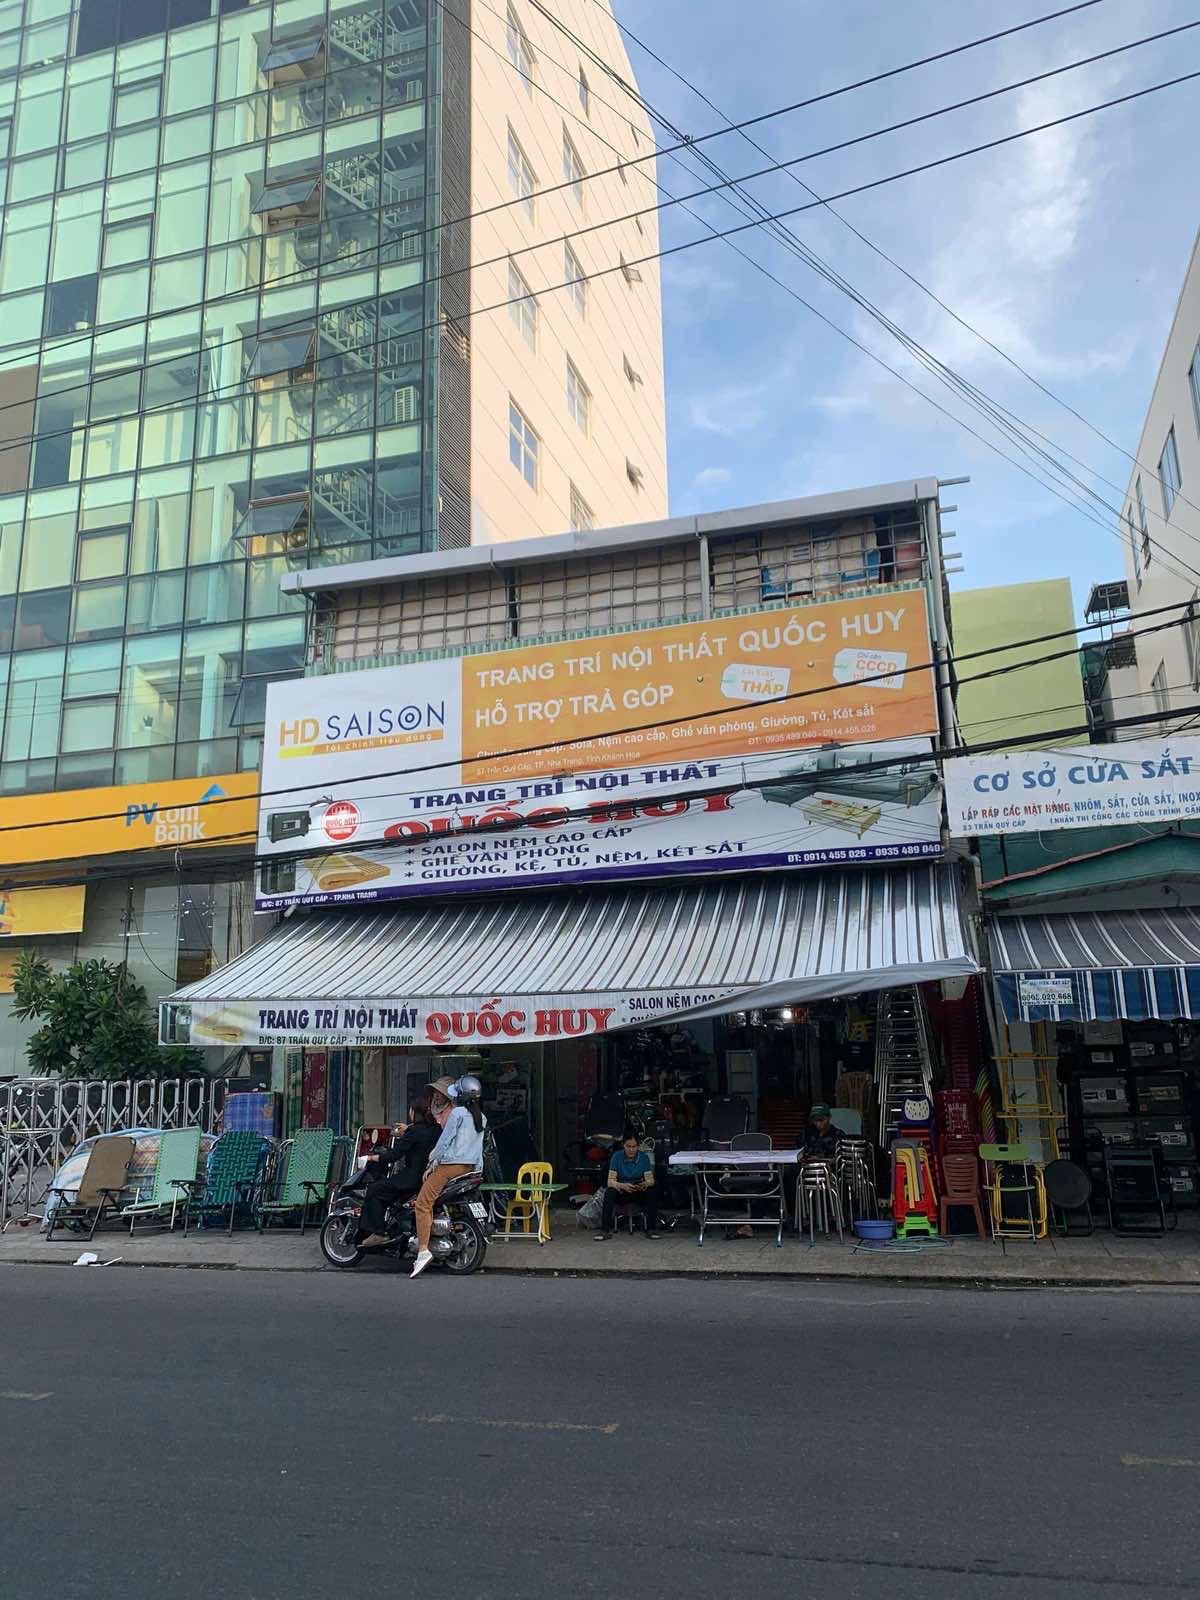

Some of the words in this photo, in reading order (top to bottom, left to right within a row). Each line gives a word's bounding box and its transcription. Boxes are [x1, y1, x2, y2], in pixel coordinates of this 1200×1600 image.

[476, 662, 554, 689] TRANG
[564, 651, 601, 676] TRÍ
[611, 646, 653, 671] NỘI
[663, 632, 728, 662] THẤT
[738, 614, 826, 652] QUỐC
[841, 608, 905, 638] HUY
[475, 697, 507, 728] HỖ
[514, 698, 563, 723] TRỢ
[568, 688, 616, 716] TRẢ
[622, 682, 674, 709] GÓP
[279, 718, 320, 746] HD
[326, 701, 445, 741] SAISON
[625, 733, 643, 744] cao
[671, 722, 694, 738] Ghế
[974, 770, 1010, 793] CƠ
[1022, 761, 1056, 789] SỞ
[1068, 757, 1129, 785] CỬA
[1141, 748, 1193, 778] SẮT
[409, 787, 506, 809] TRANG
[516, 779, 563, 799] TRÍ
[575, 773, 629, 791] NỘI
[640, 762, 721, 785] THẤT
[1002, 804, 1021, 817] CÁC
[1131, 792, 1150, 807] CỬA
[1091, 811, 1113, 821] CÔNG
[1134, 807, 1155, 817] CÔNG
[155, 821, 206, 843] Bank
[421, 841, 486, 856] SALON
[494, 837, 537, 850] NỆM
[544, 832, 585, 845] CAO
[592, 825, 633, 840] CẤP
[421, 864, 507, 880] GIƯỜNG,
[515, 859, 546, 872] KỆ,
[595, 849, 649, 864] NỆM,
[657, 845, 698, 858] KÉT
[516, 843, 590, 860] PHÒNG
[803, 852, 827, 862] 0914
[829, 850, 847, 860] 455
[848, 849, 867, 859] 026
[875, 846, 899, 857] 0935
[901, 845, 920, 855] 489
[922, 843, 941, 854] 040
[629, 997, 663, 1010] SALON
[667, 993, 691, 1011] NỆM
[258, 1009, 309, 1029] TRANG
[315, 1004, 340, 1029] TRÍ
[344, 1005, 374, 1034] NỘI
[379, 1002, 418, 1029] THẤT
[425, 996, 526, 1044] QUỐC
[534, 1007, 616, 1036] HUY
[276, 1036, 286, 1045] 87
[289, 1034, 310, 1045] TRẦN
[385, 1035, 413, 1045] TRANG
